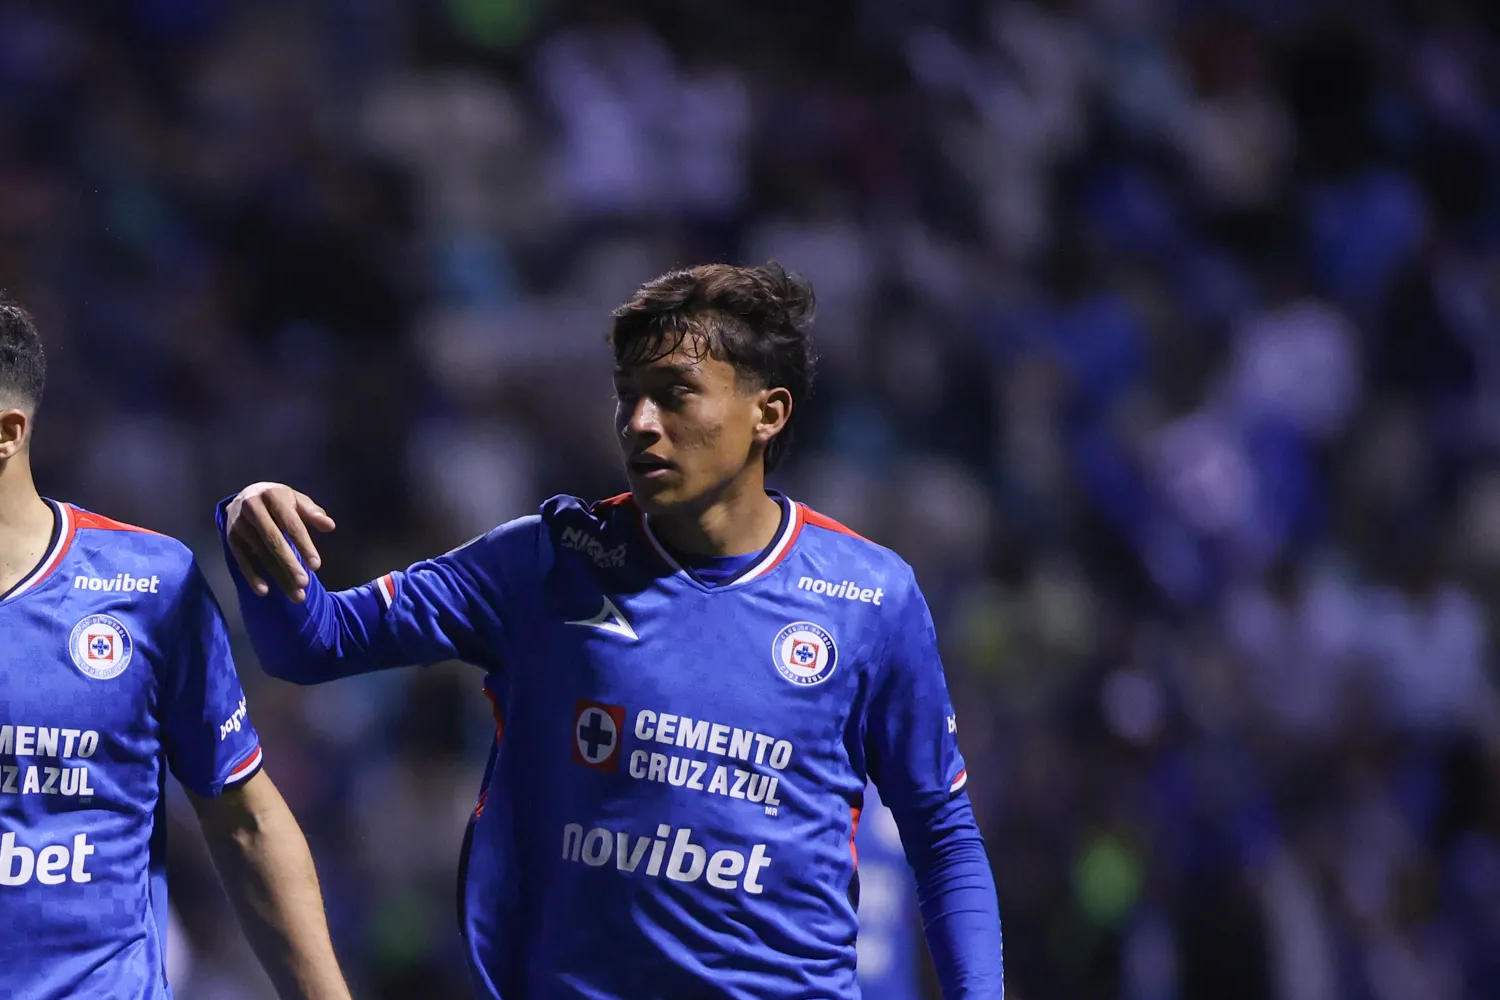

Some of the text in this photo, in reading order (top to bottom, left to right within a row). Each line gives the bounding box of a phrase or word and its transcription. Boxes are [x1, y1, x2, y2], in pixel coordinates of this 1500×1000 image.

[74, 573, 159, 593] novibet
[797, 576, 884, 605] novibet
[634, 709, 793, 769] CEMENTO
[22, 765, 94, 796] AZUL
[629, 749, 780, 806] CRUZ AZUL
[562, 823, 771, 894] novibet
